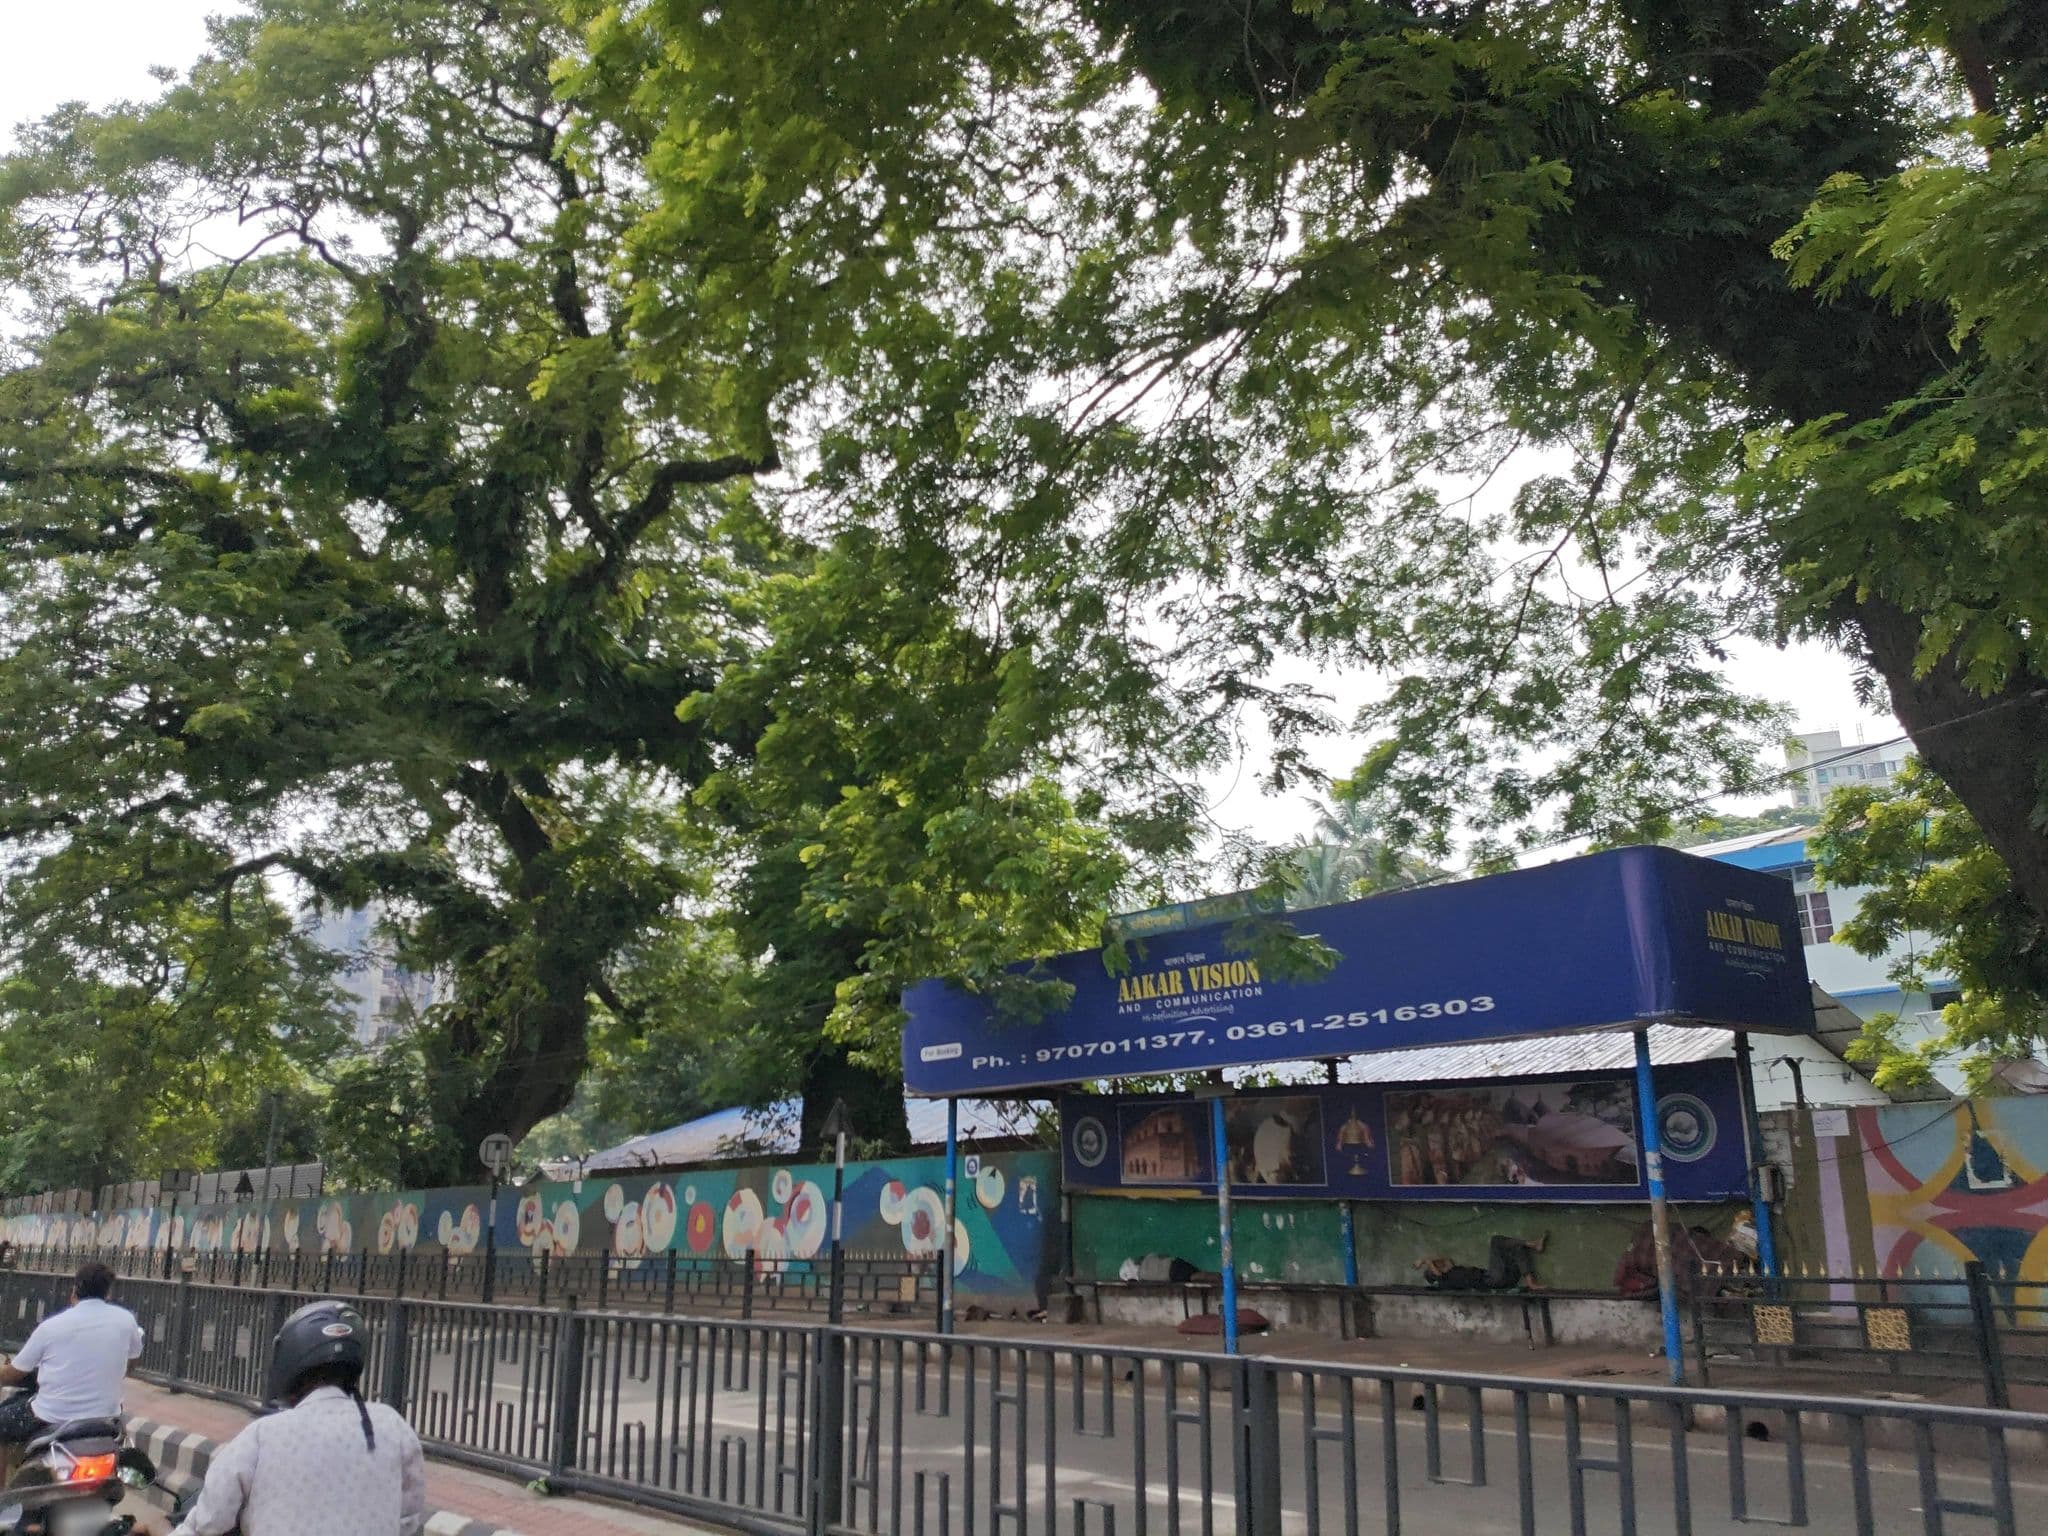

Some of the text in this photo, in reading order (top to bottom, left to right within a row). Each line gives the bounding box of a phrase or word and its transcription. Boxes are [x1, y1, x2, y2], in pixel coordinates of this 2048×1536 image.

[1706, 909, 1745, 943] AAKAR
[1118, 958, 1260, 1002] AAKAR VISION
[1118, 986, 1263, 1014] AND COMMUNICATION
[972, 1055, 1011, 1070] Ph.
[1036, 1030, 1215, 1062] 9707011377,
[1226, 996, 1495, 1040] 0361-2516303
